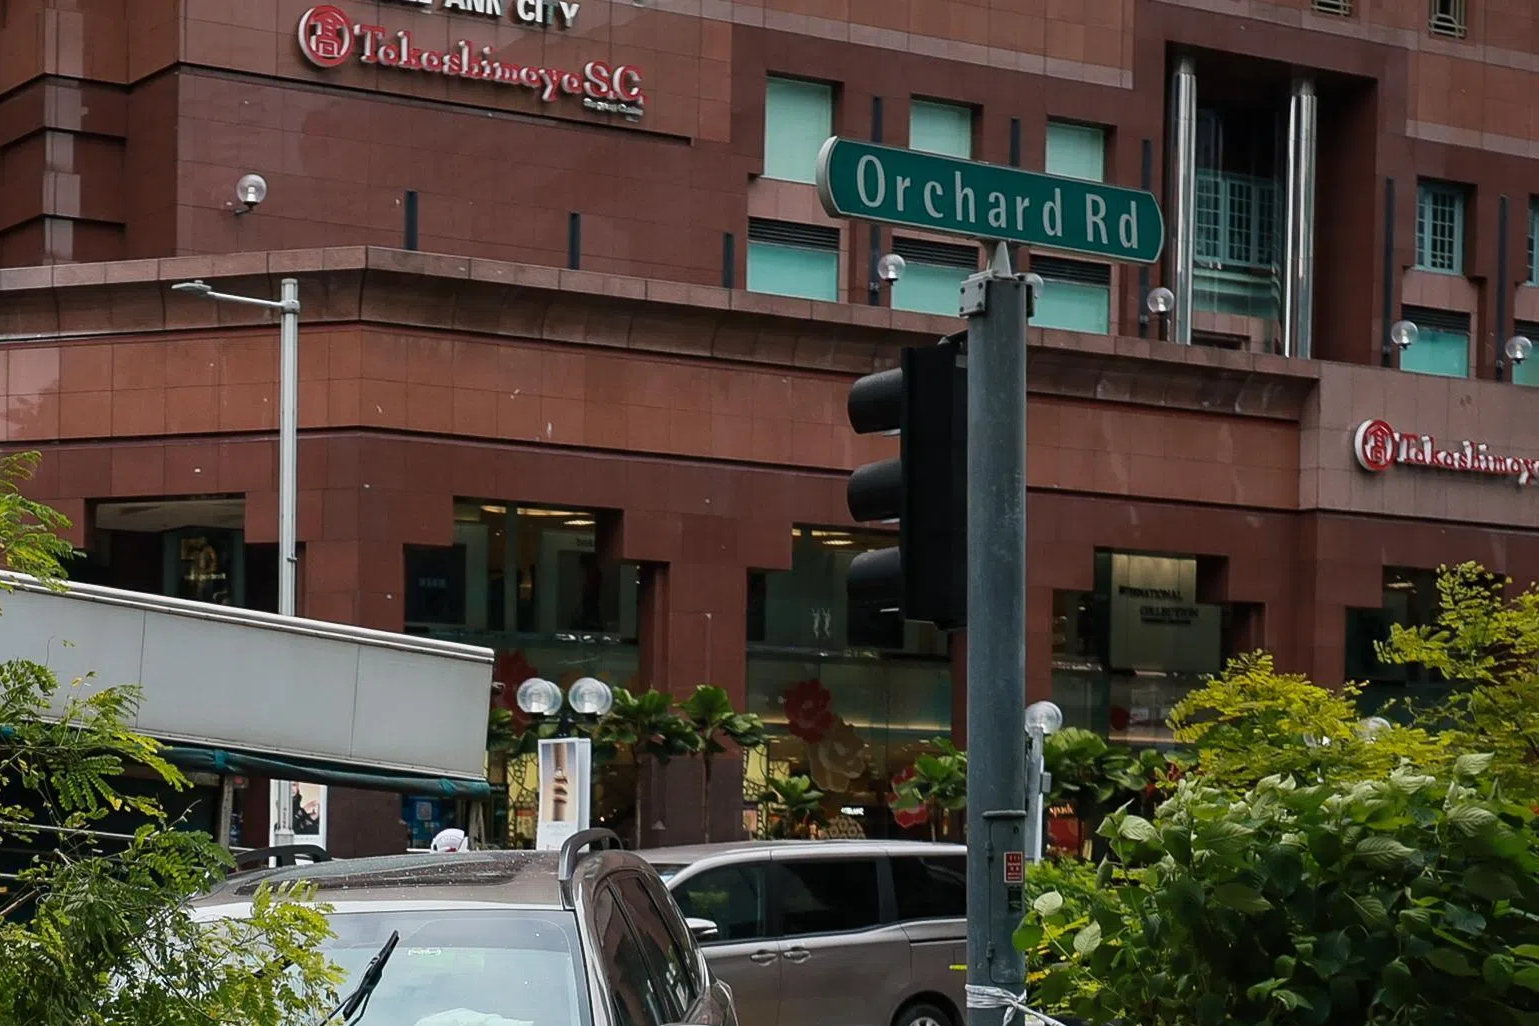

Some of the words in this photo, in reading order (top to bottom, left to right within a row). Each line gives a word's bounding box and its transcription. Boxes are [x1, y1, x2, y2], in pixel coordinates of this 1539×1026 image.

[517, 0, 580, 27] CITY
[856, 153, 1063, 238] Orchard
[1085, 192, 1139, 249] Rd
[1394, 432, 1539, 486] Takashimay
